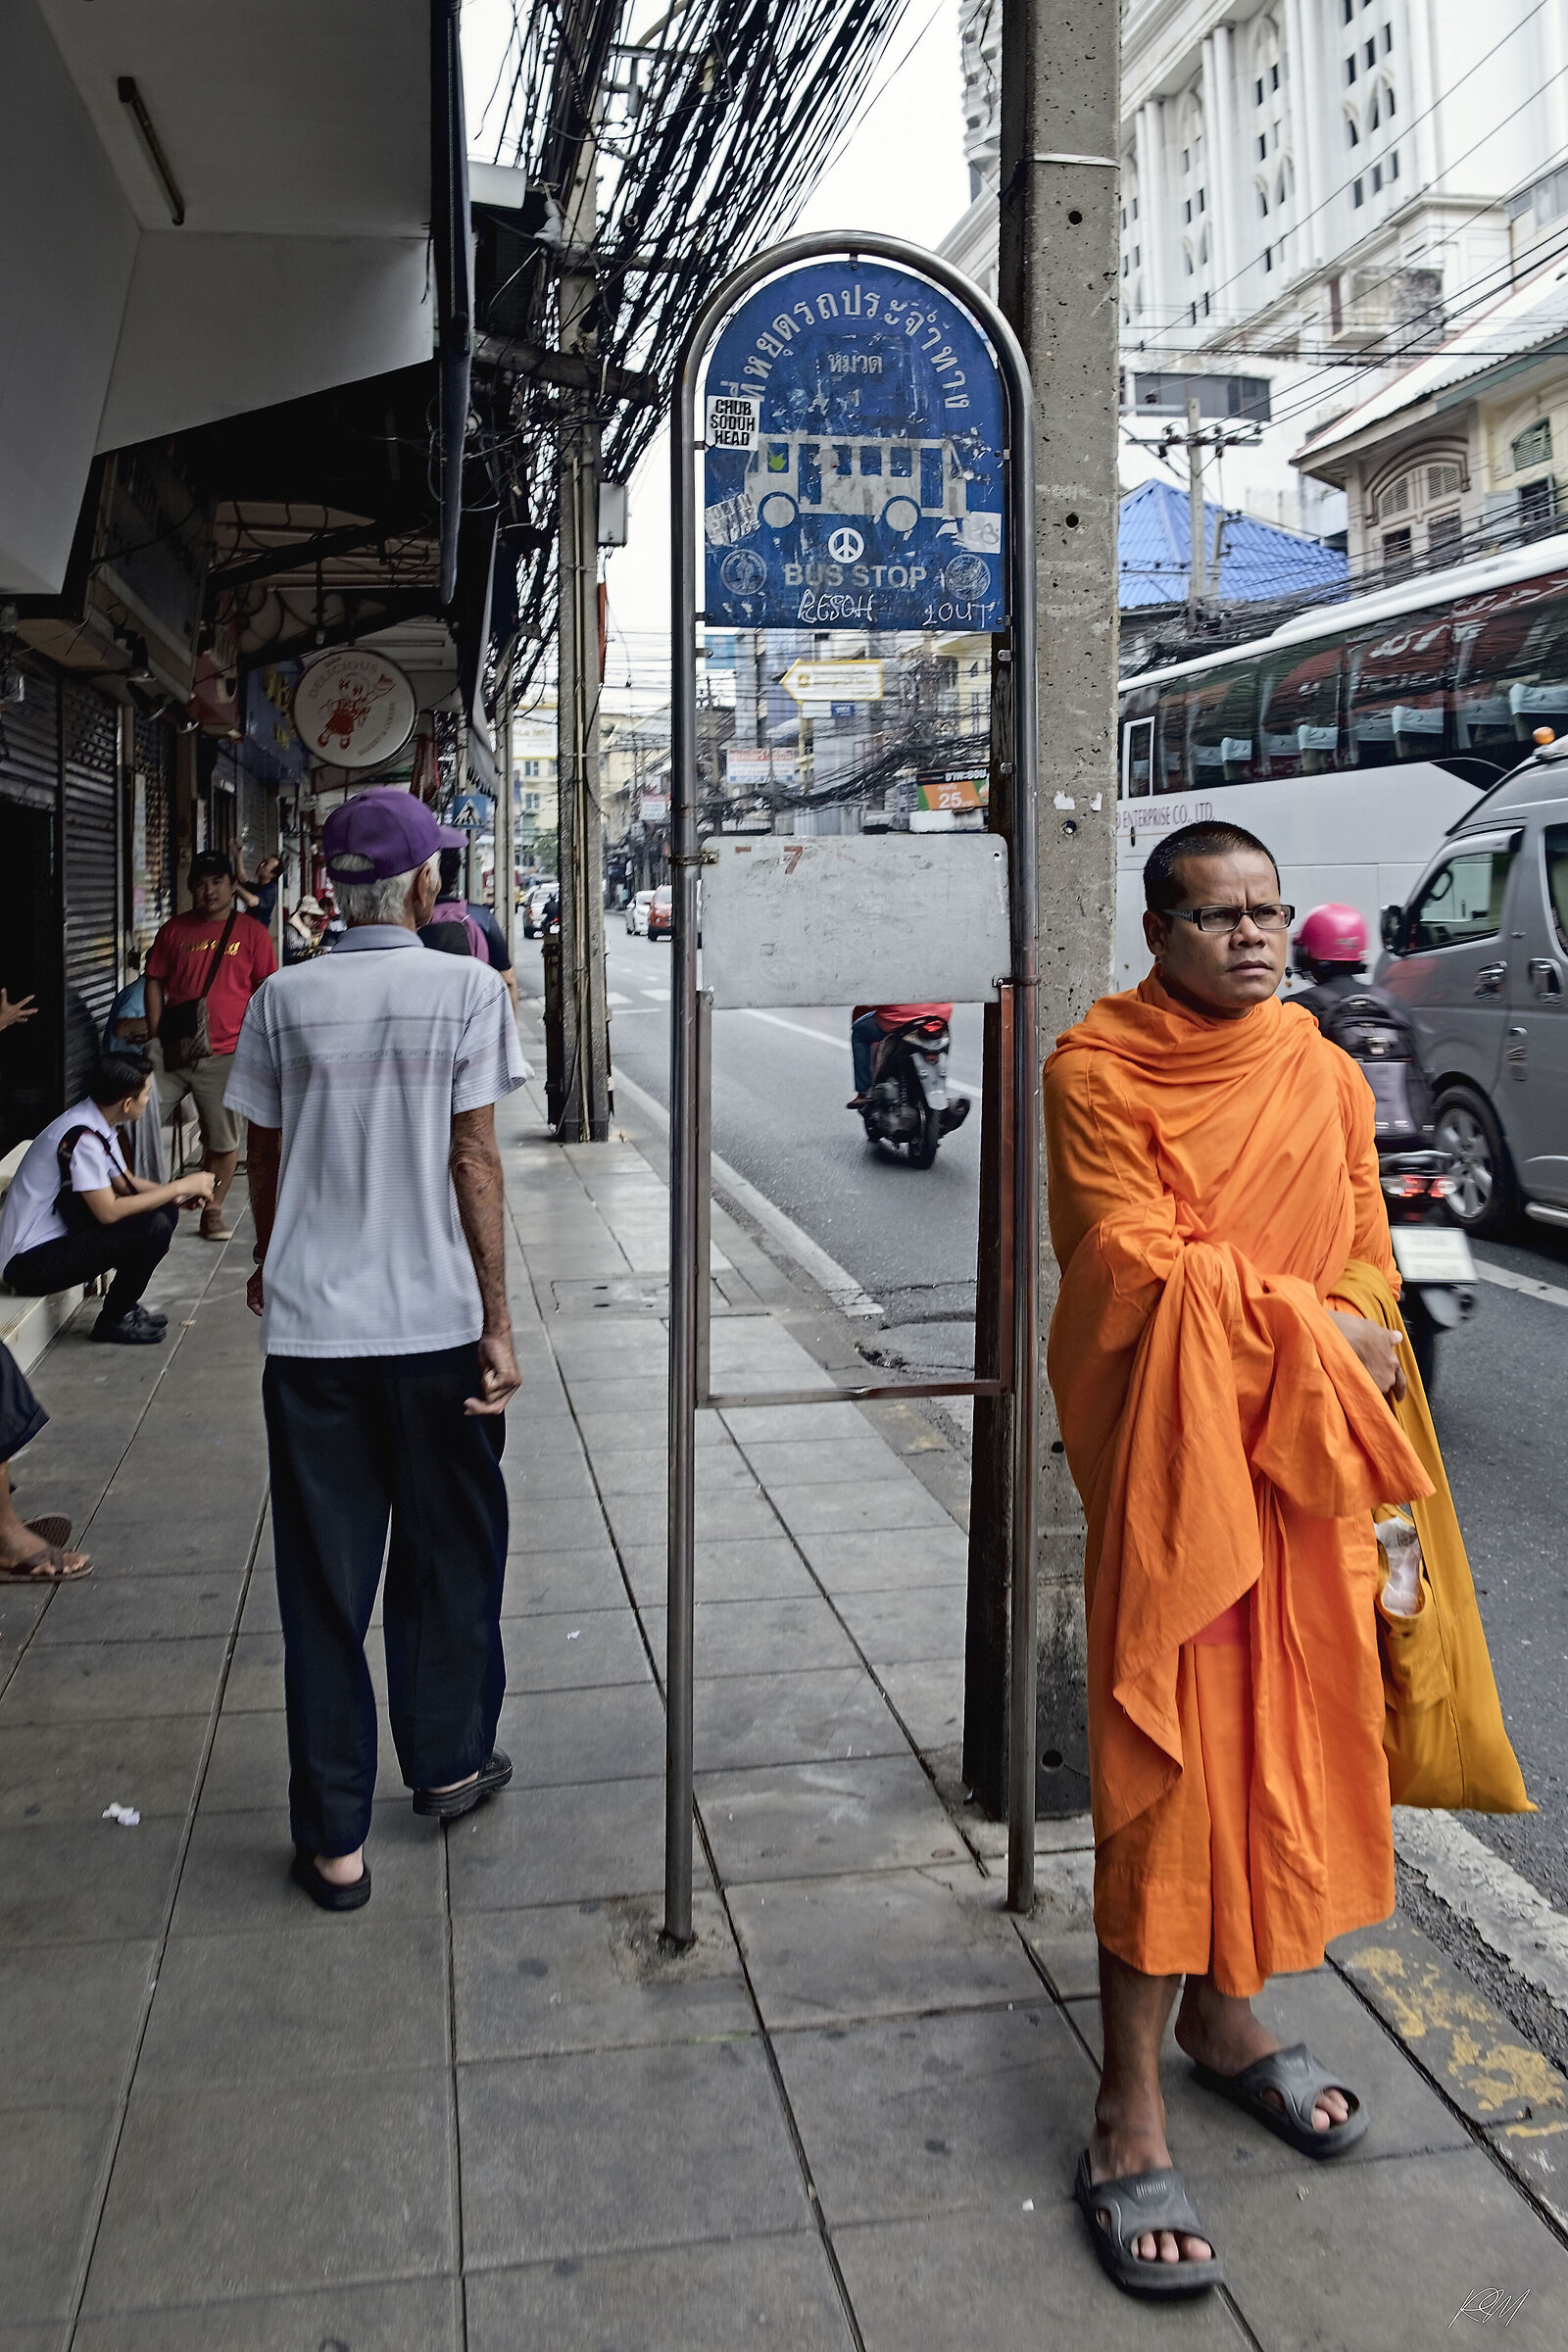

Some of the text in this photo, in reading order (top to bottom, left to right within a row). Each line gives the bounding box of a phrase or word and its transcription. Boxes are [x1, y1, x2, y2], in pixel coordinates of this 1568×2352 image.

[715, 399, 752, 416] CHUB
[710, 415, 756, 431] SODUH
[714, 429, 750, 446] HEAD
[785, 564, 927, 588] BUS STOP
[939, 792, 962, 808] 25
[1123, 807, 1171, 828] ENTERPRISE
